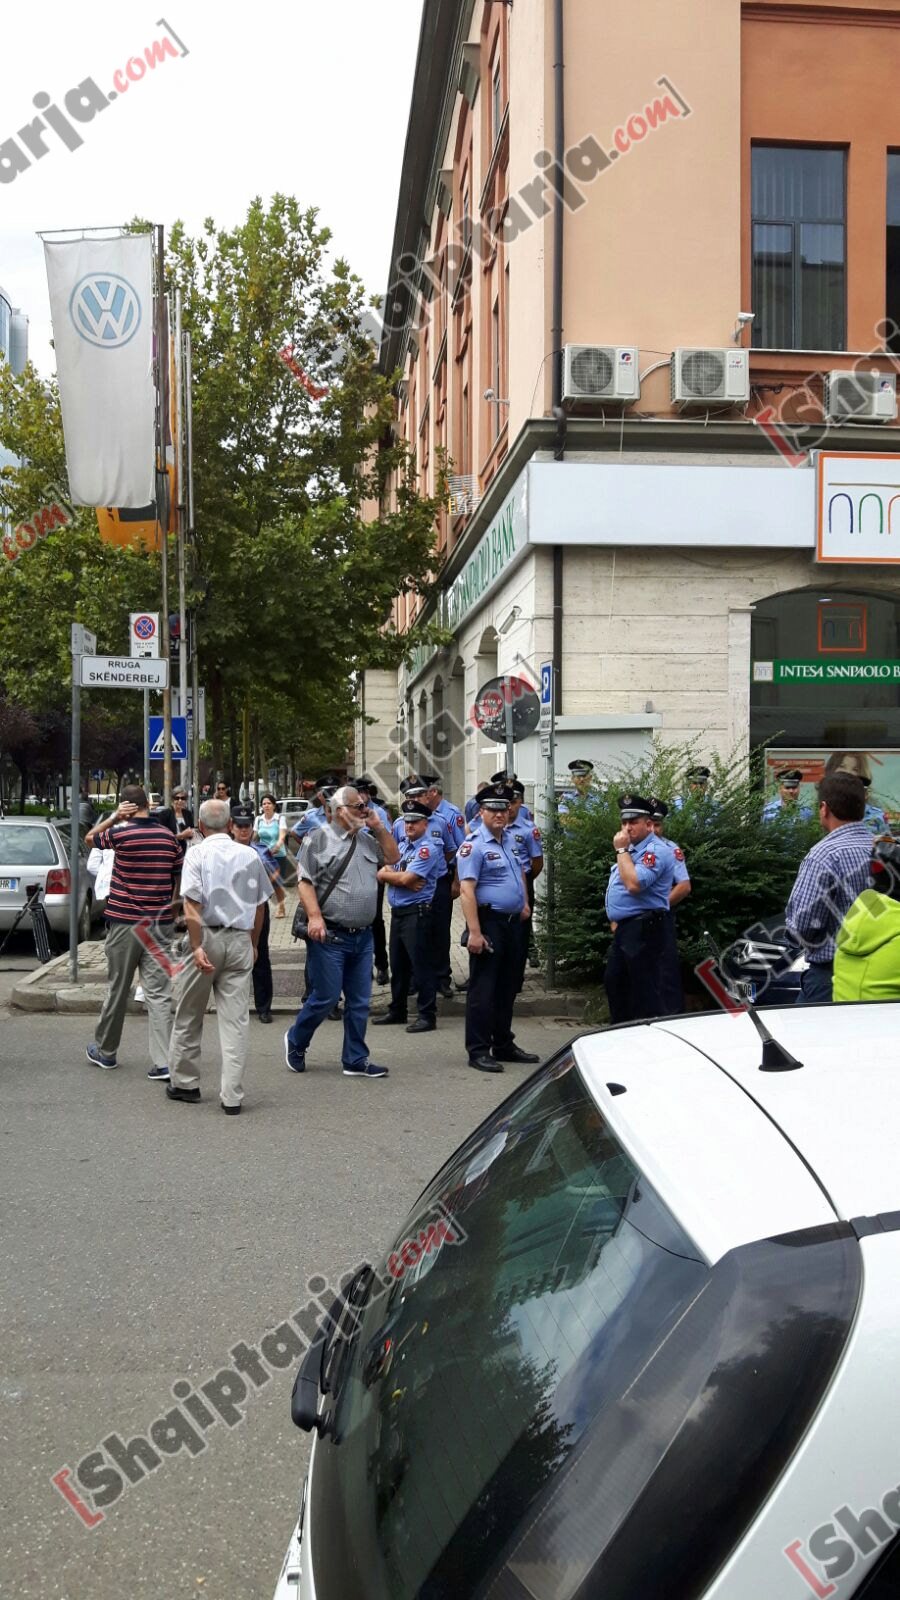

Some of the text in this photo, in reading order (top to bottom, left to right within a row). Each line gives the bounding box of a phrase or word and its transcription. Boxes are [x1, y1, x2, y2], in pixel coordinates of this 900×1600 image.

[491, 495, 516, 579] BANK
[108, 660, 141, 669] RRUGA
[780, 665, 824, 678] INTESA
[826, 665, 891, 678] SANPAOLO
[89, 672, 160, 684] SKËNDERBEJ
